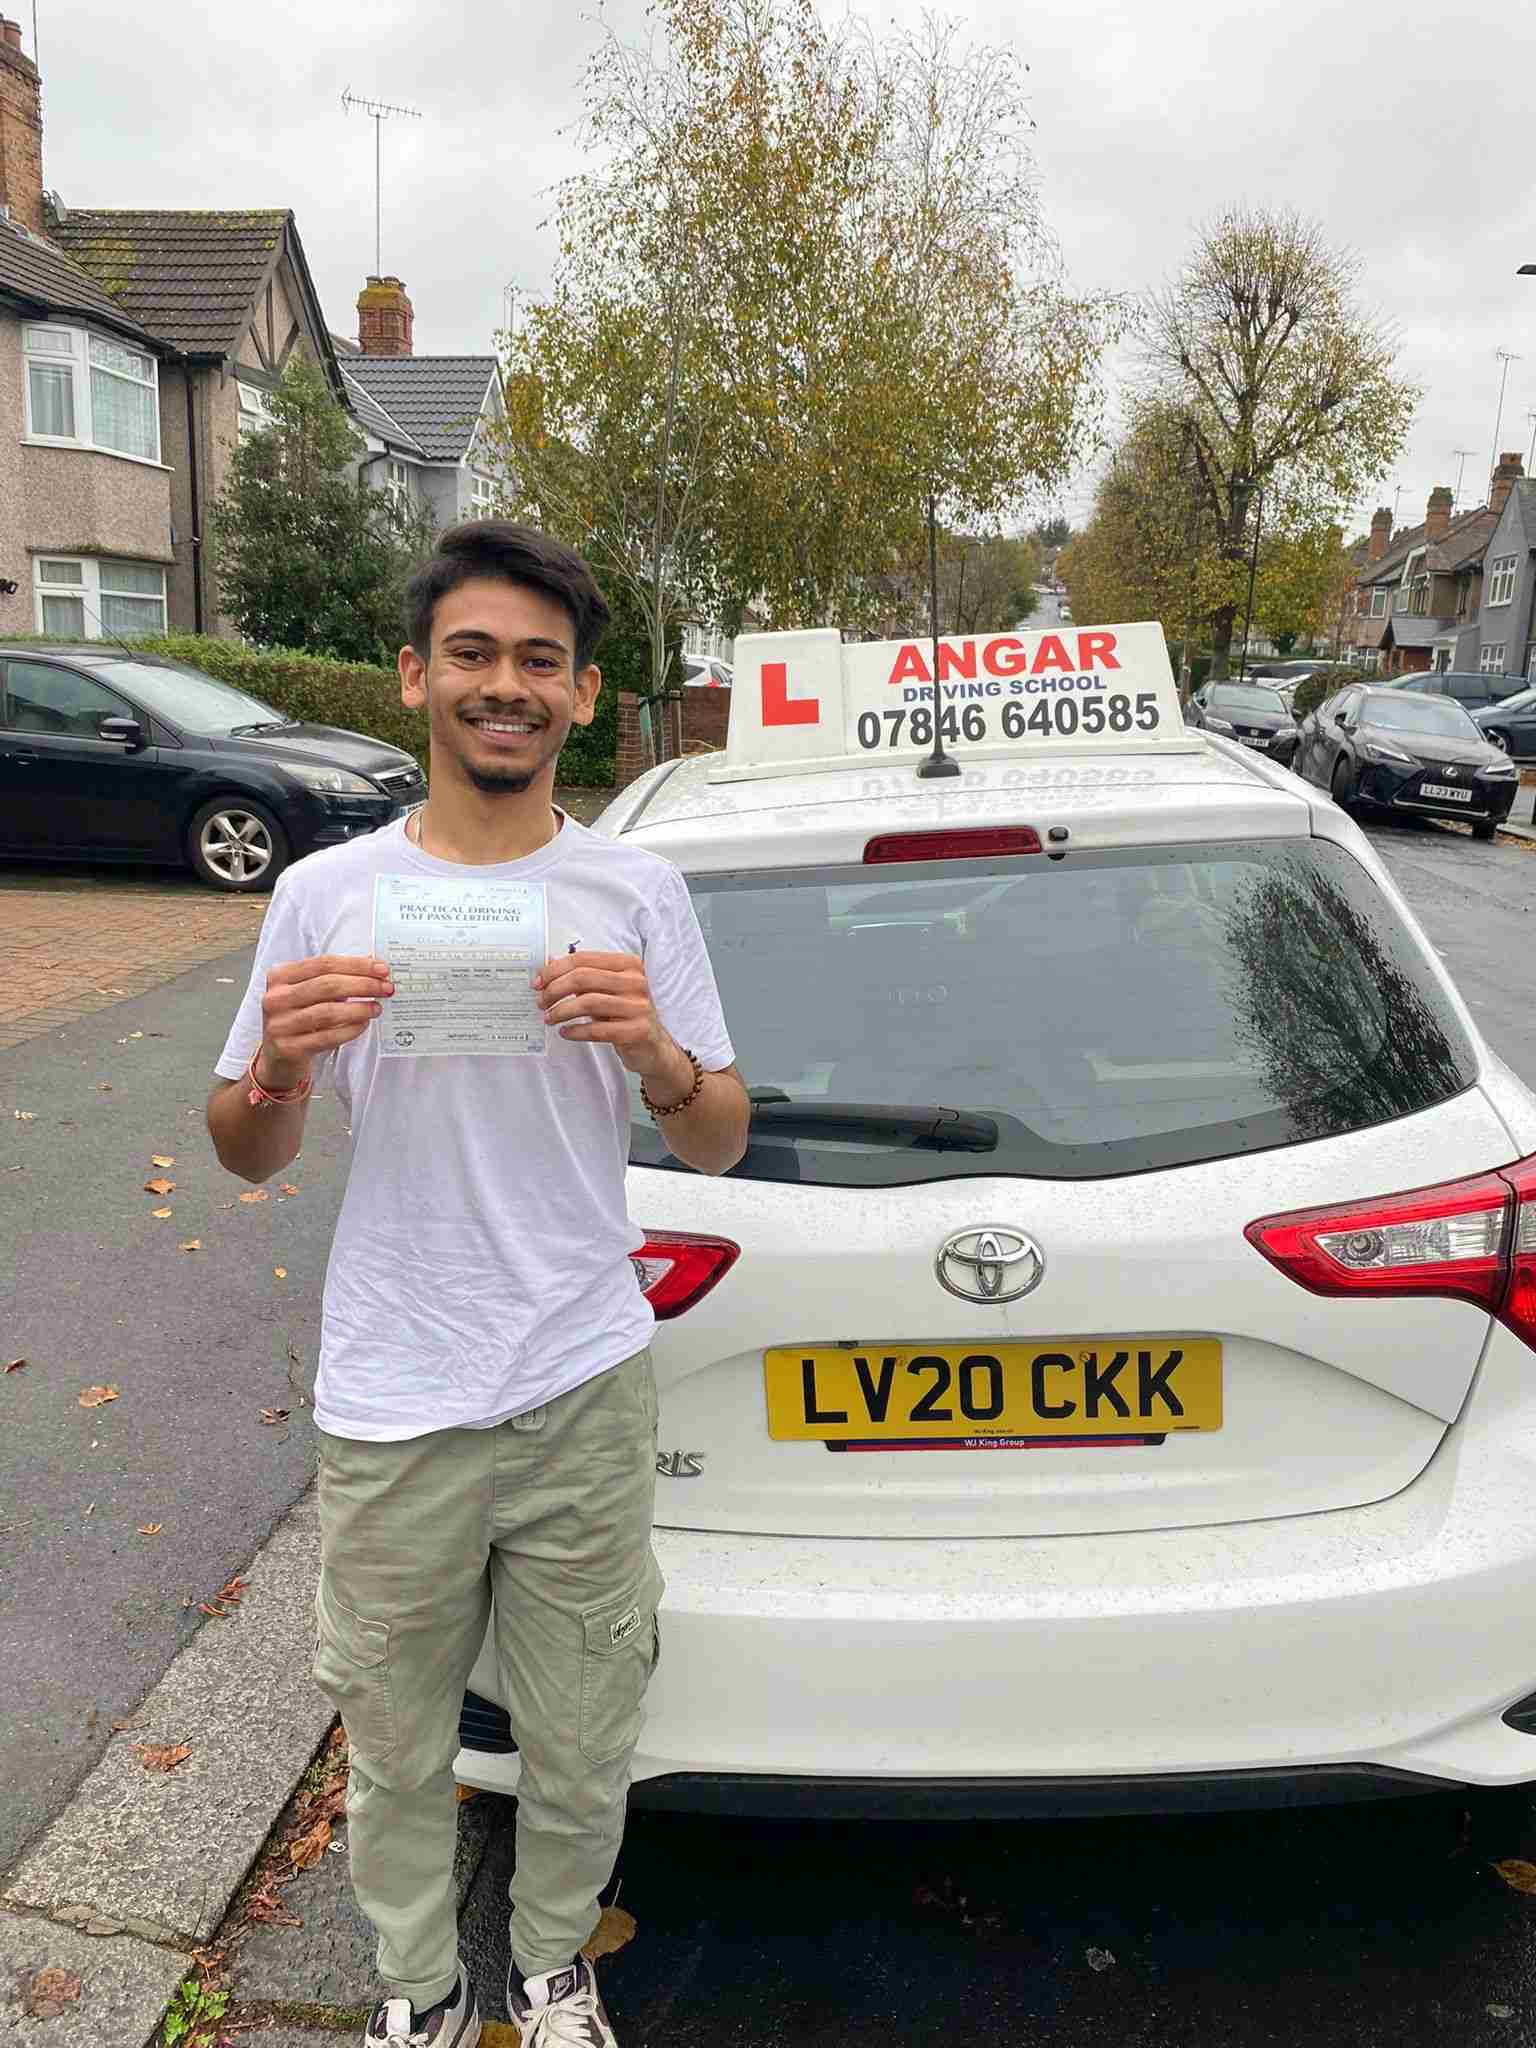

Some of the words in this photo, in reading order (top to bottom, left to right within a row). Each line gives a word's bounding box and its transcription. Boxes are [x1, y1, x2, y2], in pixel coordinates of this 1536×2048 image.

[888, 632, 1120, 684] ANGAR
[761, 663, 819, 726] L
[903, 682, 1000, 702] DRVING
[1009, 676, 1107, 694] SCHOOL
[857, 703, 986, 749] 07846
[1001, 693, 1160, 739] 640585
[399, 903, 463, 913] PRACTICAL
[468, 905, 521, 915] DRIVING
[400, 913, 423, 921] TEST
[427, 913, 452, 921] PASS
[455, 914, 521, 923] CERTIFICATE
[801, 1356, 1005, 1424] LV20
[1031, 1350, 1184, 1418] CKK
[978, 1438, 997, 1449] King
[999, 1437, 1025, 1448] Group
